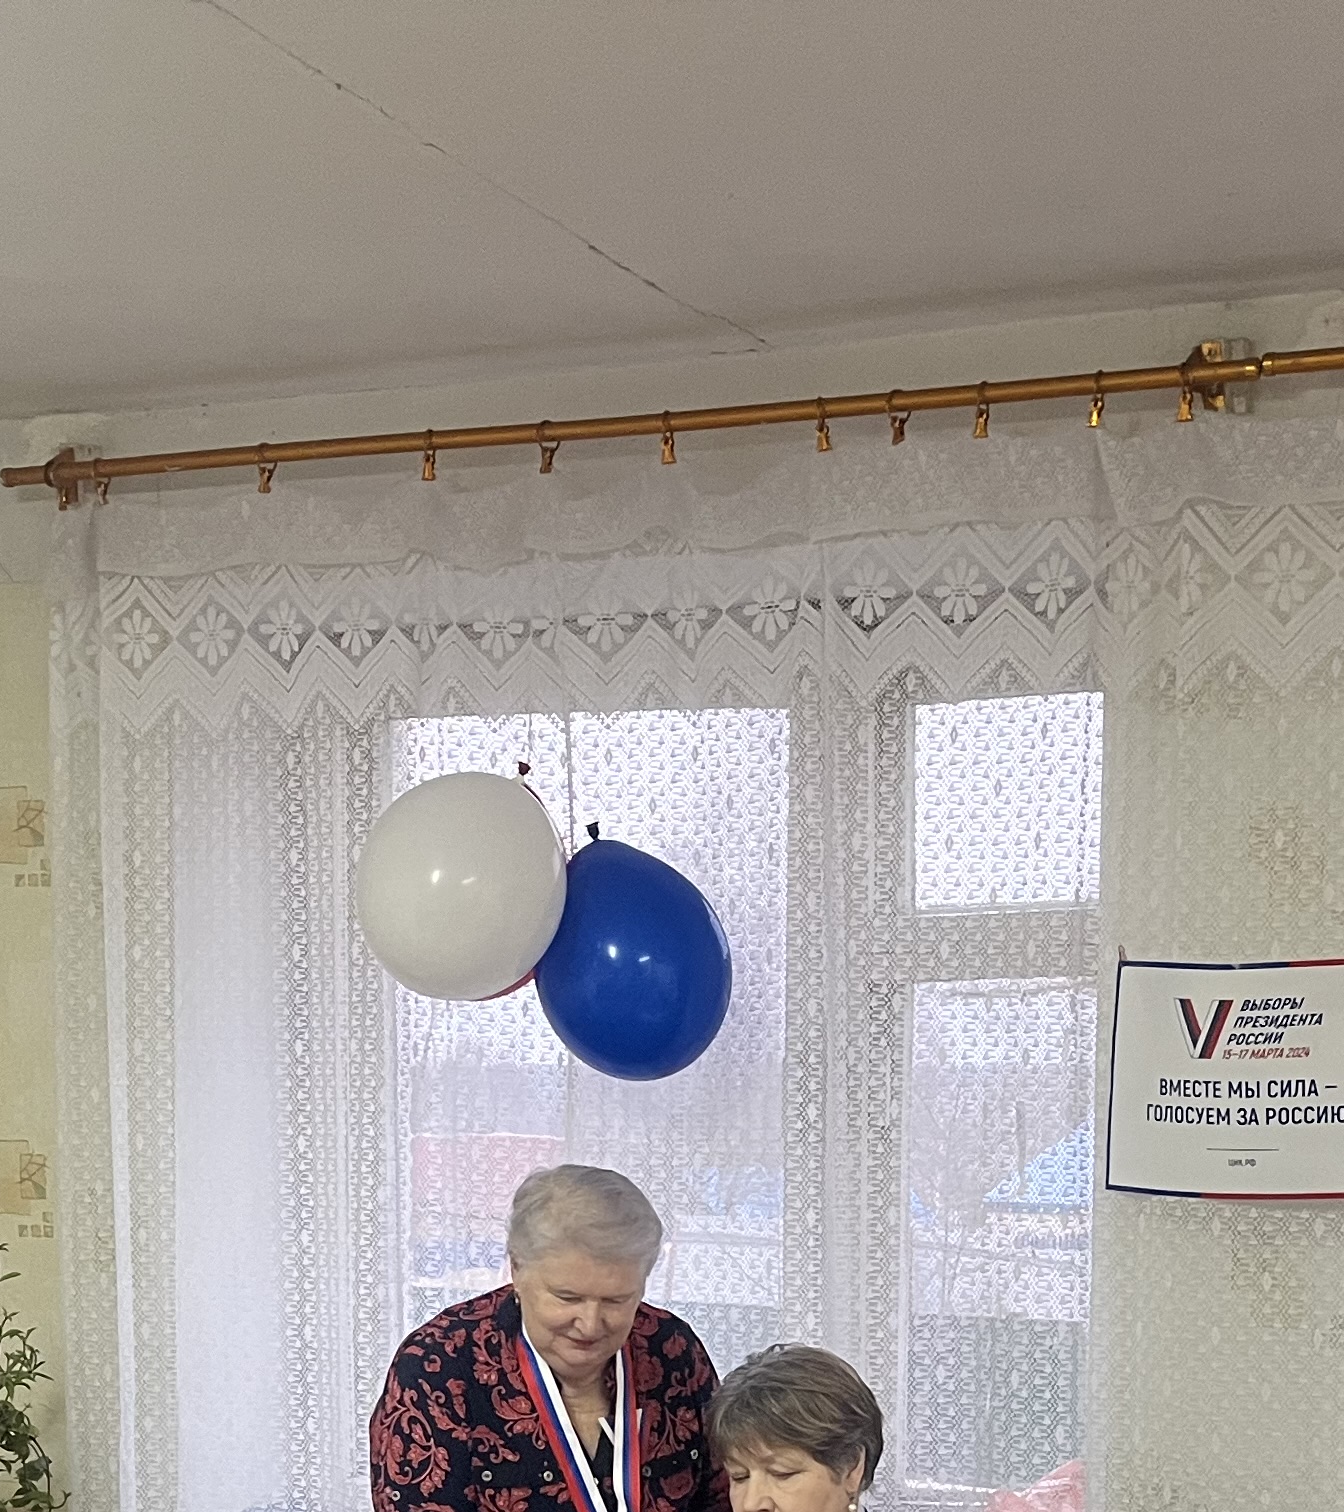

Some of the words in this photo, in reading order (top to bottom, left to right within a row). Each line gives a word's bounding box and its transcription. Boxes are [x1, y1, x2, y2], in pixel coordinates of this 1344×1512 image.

[1240, 997, 1305, 1012] ВЫБОРЫ
[1233, 1013, 1324, 1029] ПРЕЗИДЕНТА
[1227, 1032, 1285, 1046] РОССИИ
[1249, 1048, 1285, 1059] МАРТА
[1286, 1046, 1311, 1058] 2024
[1159, 1078, 1222, 1098] ВМЕСТЕ
[1228, 1080, 1260, 1099] МЫ
[1267, 1079, 1319, 1098] СИЛА
[1146, 1103, 1231, 1126] ГОЛОСУЕМ
[1236, 1107, 1260, 1126] ЗА
